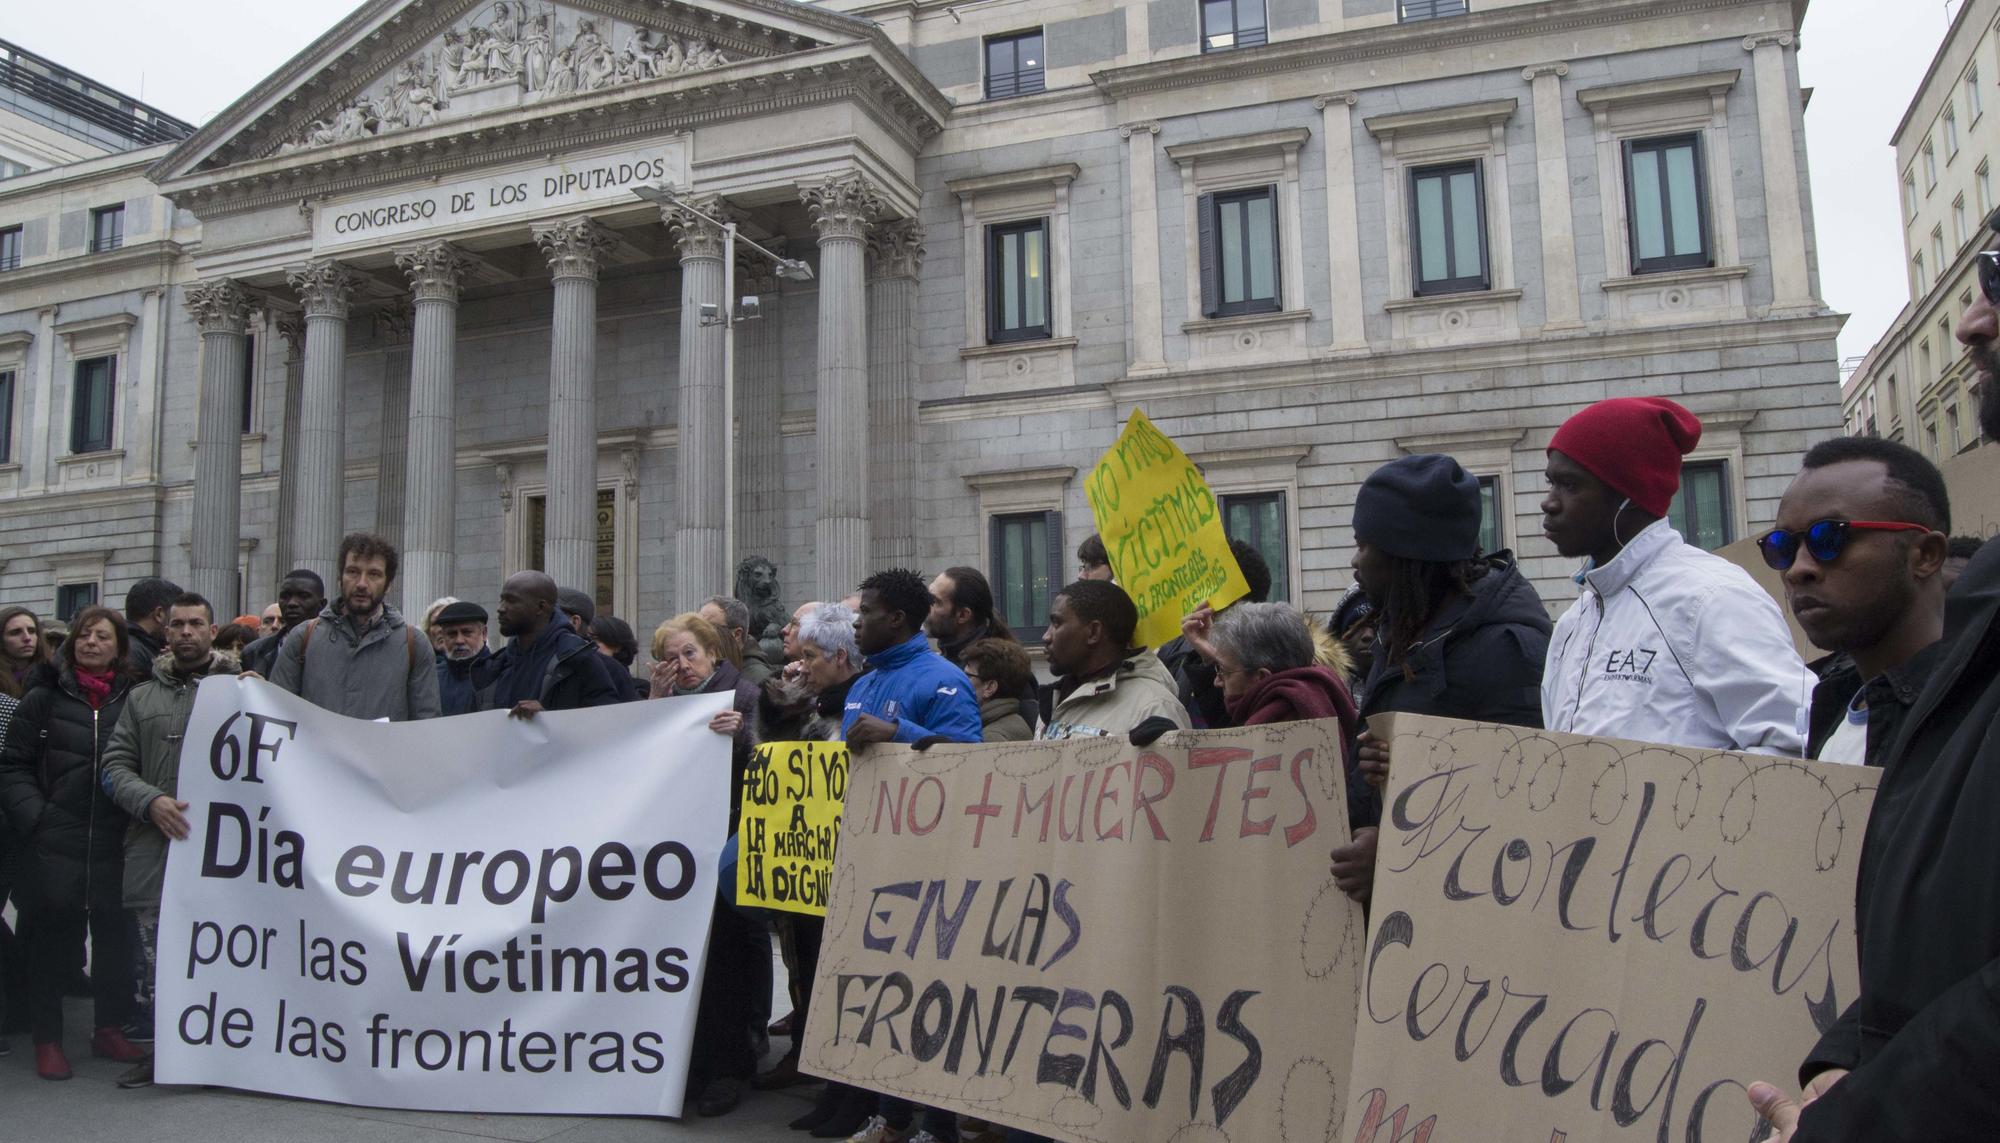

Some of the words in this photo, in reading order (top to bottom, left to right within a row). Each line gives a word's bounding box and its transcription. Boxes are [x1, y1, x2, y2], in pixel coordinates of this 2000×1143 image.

[335, 200, 436, 234] CONGRESO
[451, 192, 475, 214] DE
[490, 184, 527, 207] LOS
[544, 158, 664, 197] DIPUTADOS
[1091, 462, 1120, 531] NO
[1606, 649, 1657, 673] EA7
[209, 710, 297, 784] 6F
[789, 804, 808, 834] A
[873, 775, 946, 836] NO
[1012, 746, 1318, 849] MUERTES
[201, 802, 305, 891] Día
[334, 840, 696, 923] europeo
[746, 817, 766, 853] LA
[745, 854, 767, 901] LA
[187, 920, 277, 979] por
[299, 919, 368, 986] las
[397, 931, 690, 993] Víctimas
[863, 878, 982, 961] EN
[981, 872, 1081, 972] LAS
[178, 992, 254, 1049] de
[275, 999, 347, 1063] las
[366, 1013, 665, 1074] fronteras
[835, 971, 1262, 1130] FRONTERAS
